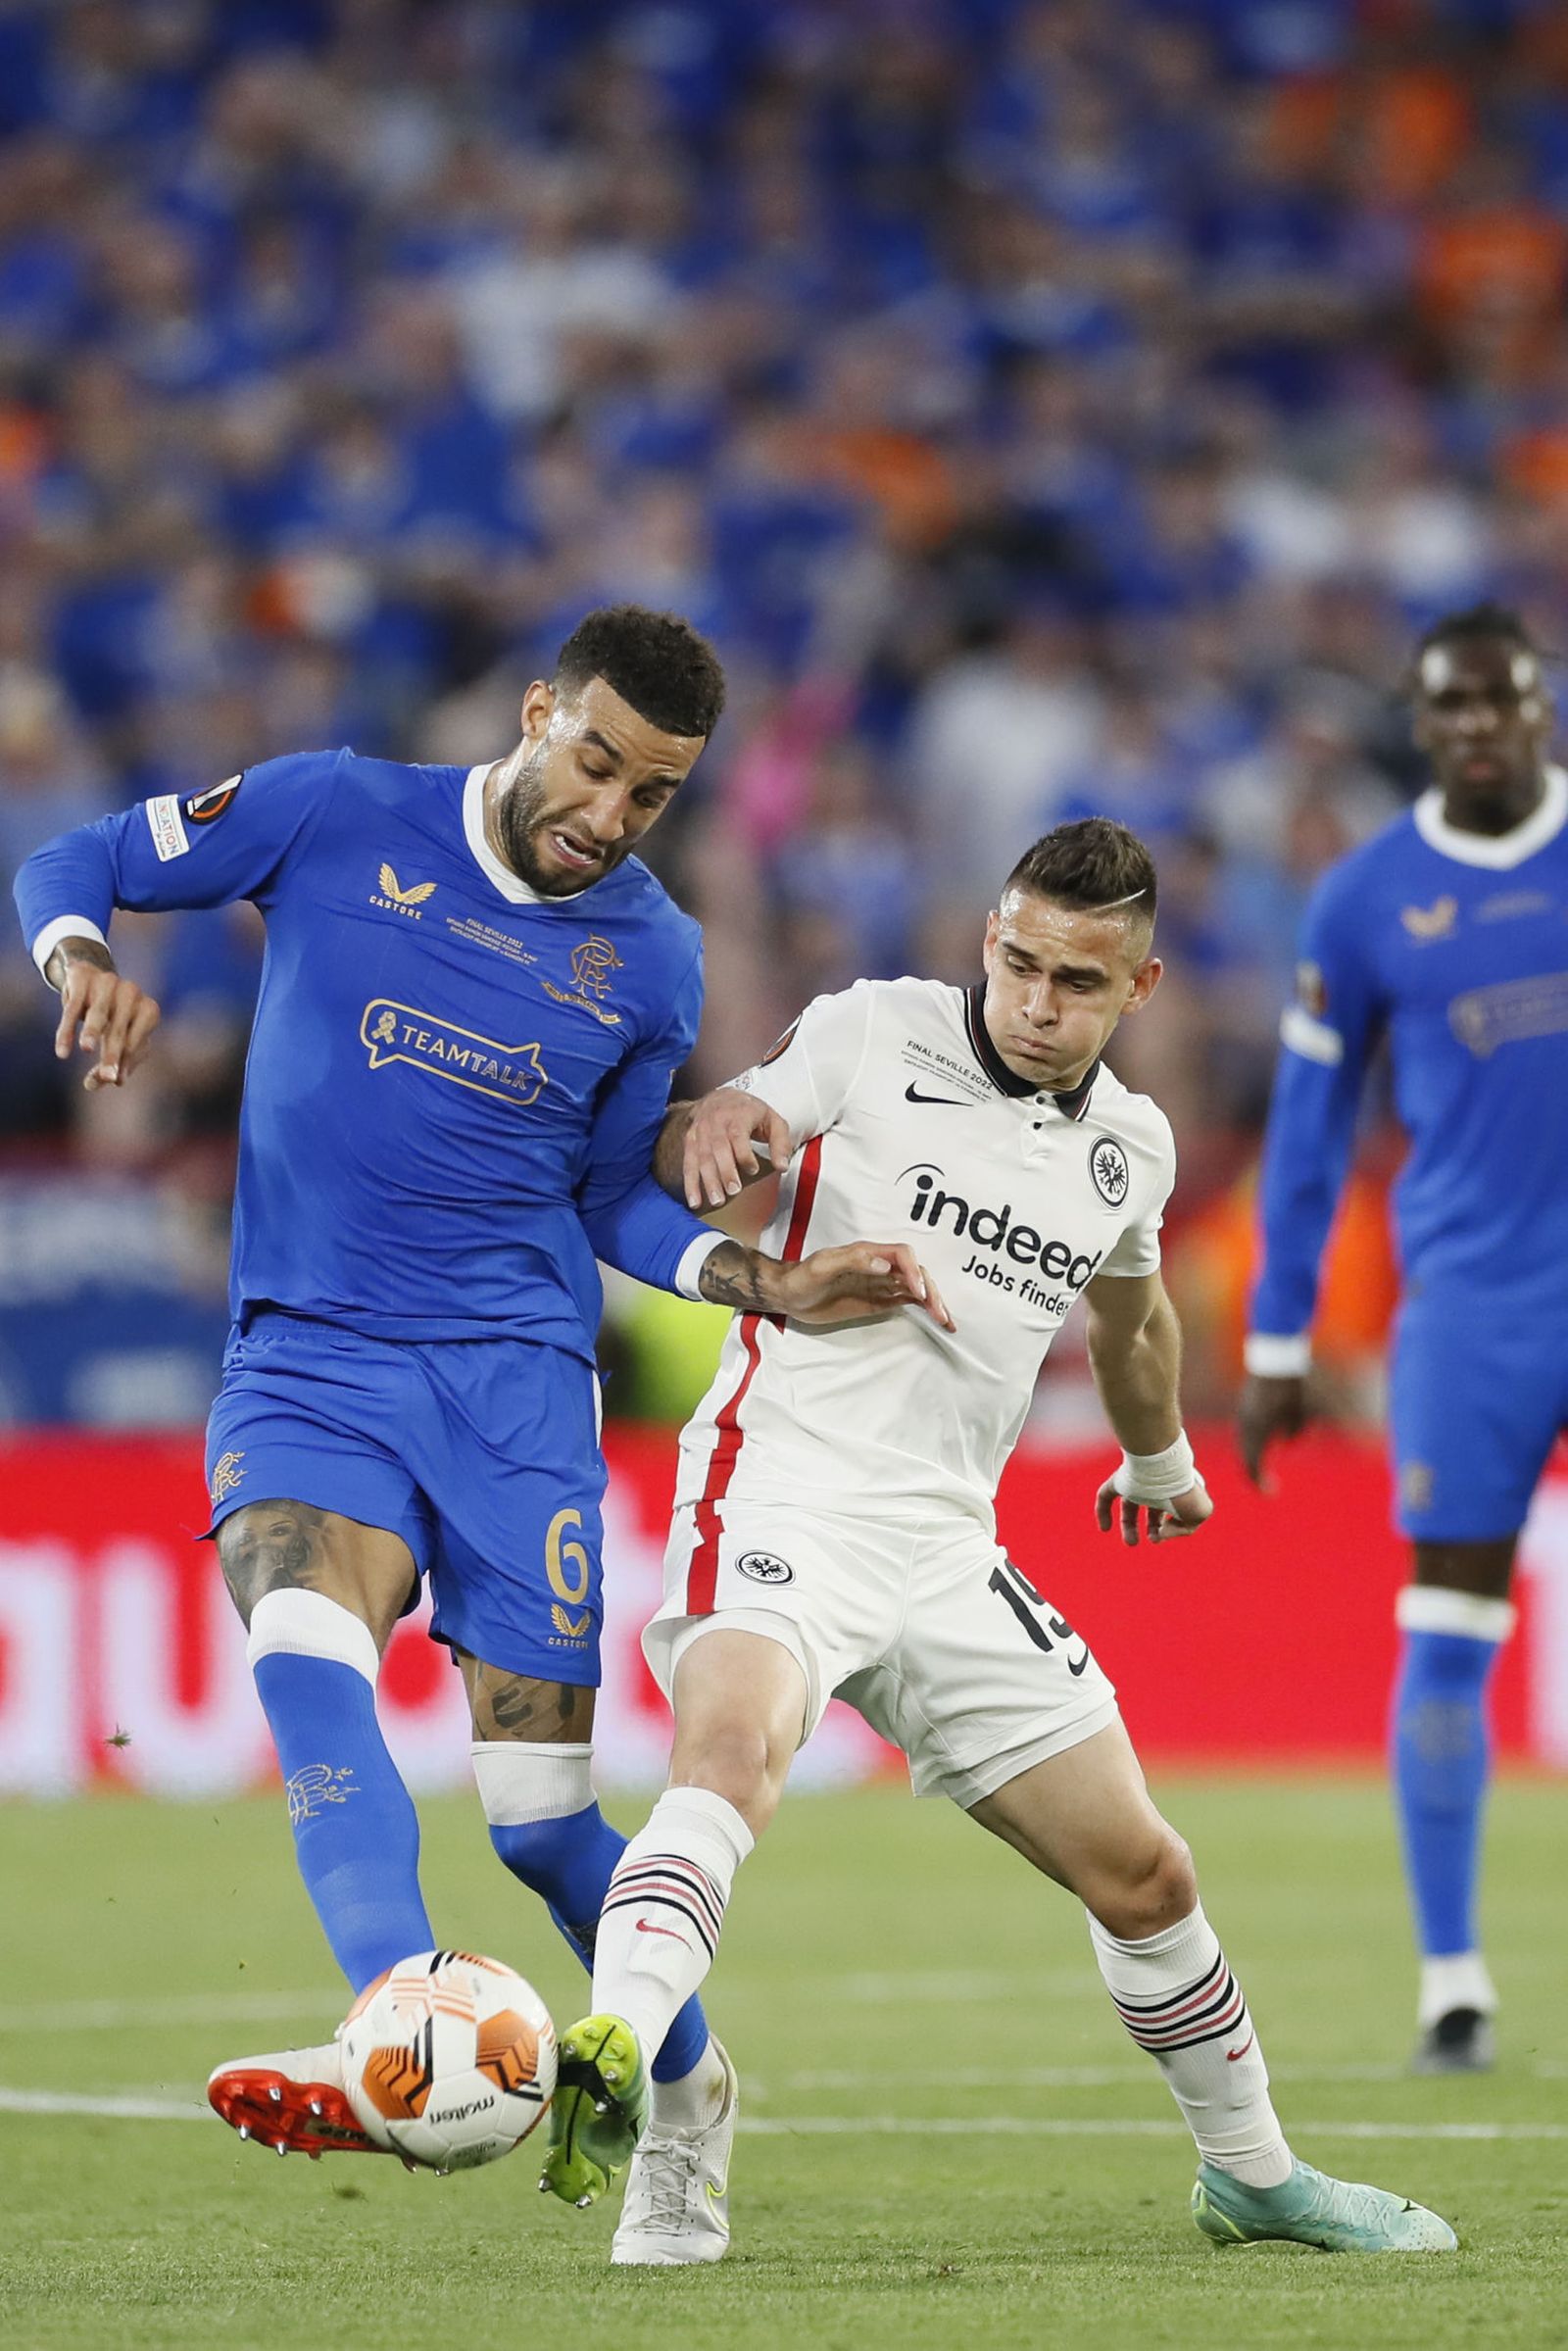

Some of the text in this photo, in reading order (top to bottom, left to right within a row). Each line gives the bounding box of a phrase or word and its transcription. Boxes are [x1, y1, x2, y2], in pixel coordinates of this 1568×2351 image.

[368, 895, 423, 920] CASTORE
[402, 1024, 534, 1091] TEAMTALK
[906, 1040, 933, 1058] FINAL
[935, 1053, 970, 1076] SEVILLE
[970, 1073, 994, 1091] 2022
[909, 1174, 1102, 1293] indeed
[961, 1255, 1014, 1293] Jobs
[545, 1508, 588, 1604] 6
[429, 2095, 494, 2125] molten
